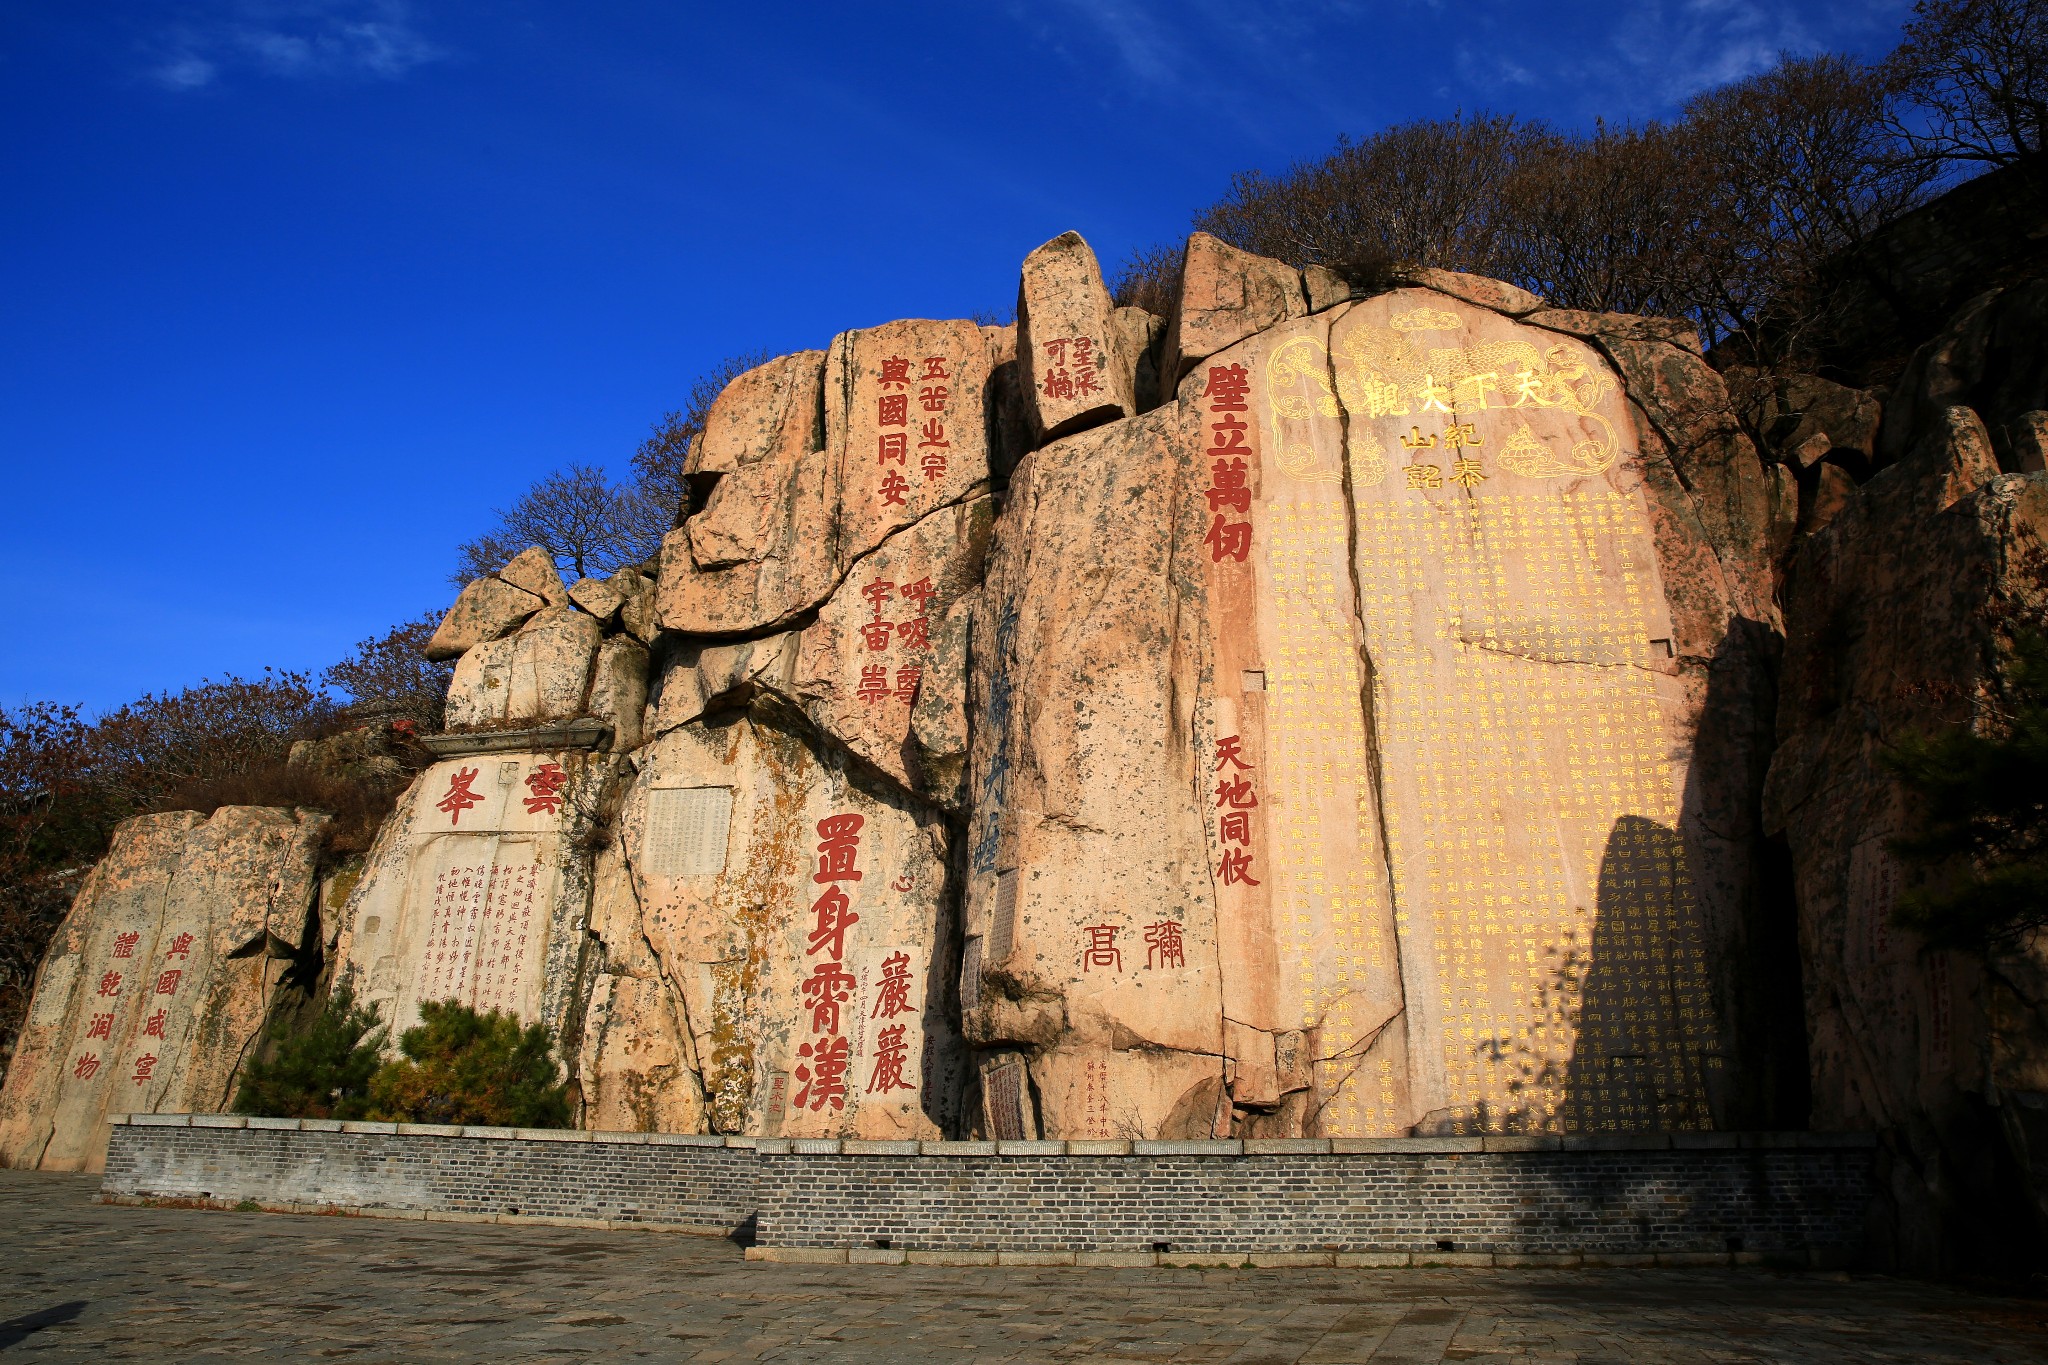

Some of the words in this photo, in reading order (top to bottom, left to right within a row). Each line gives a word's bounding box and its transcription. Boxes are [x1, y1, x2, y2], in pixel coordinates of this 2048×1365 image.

[1203, 362, 1253, 563] 壁立萬仞
[1363, 372, 1556, 419] 天下大觀
[1215, 734, 1261, 887] 天地同攸
[793, 813, 865, 1112] 置身霄漢
